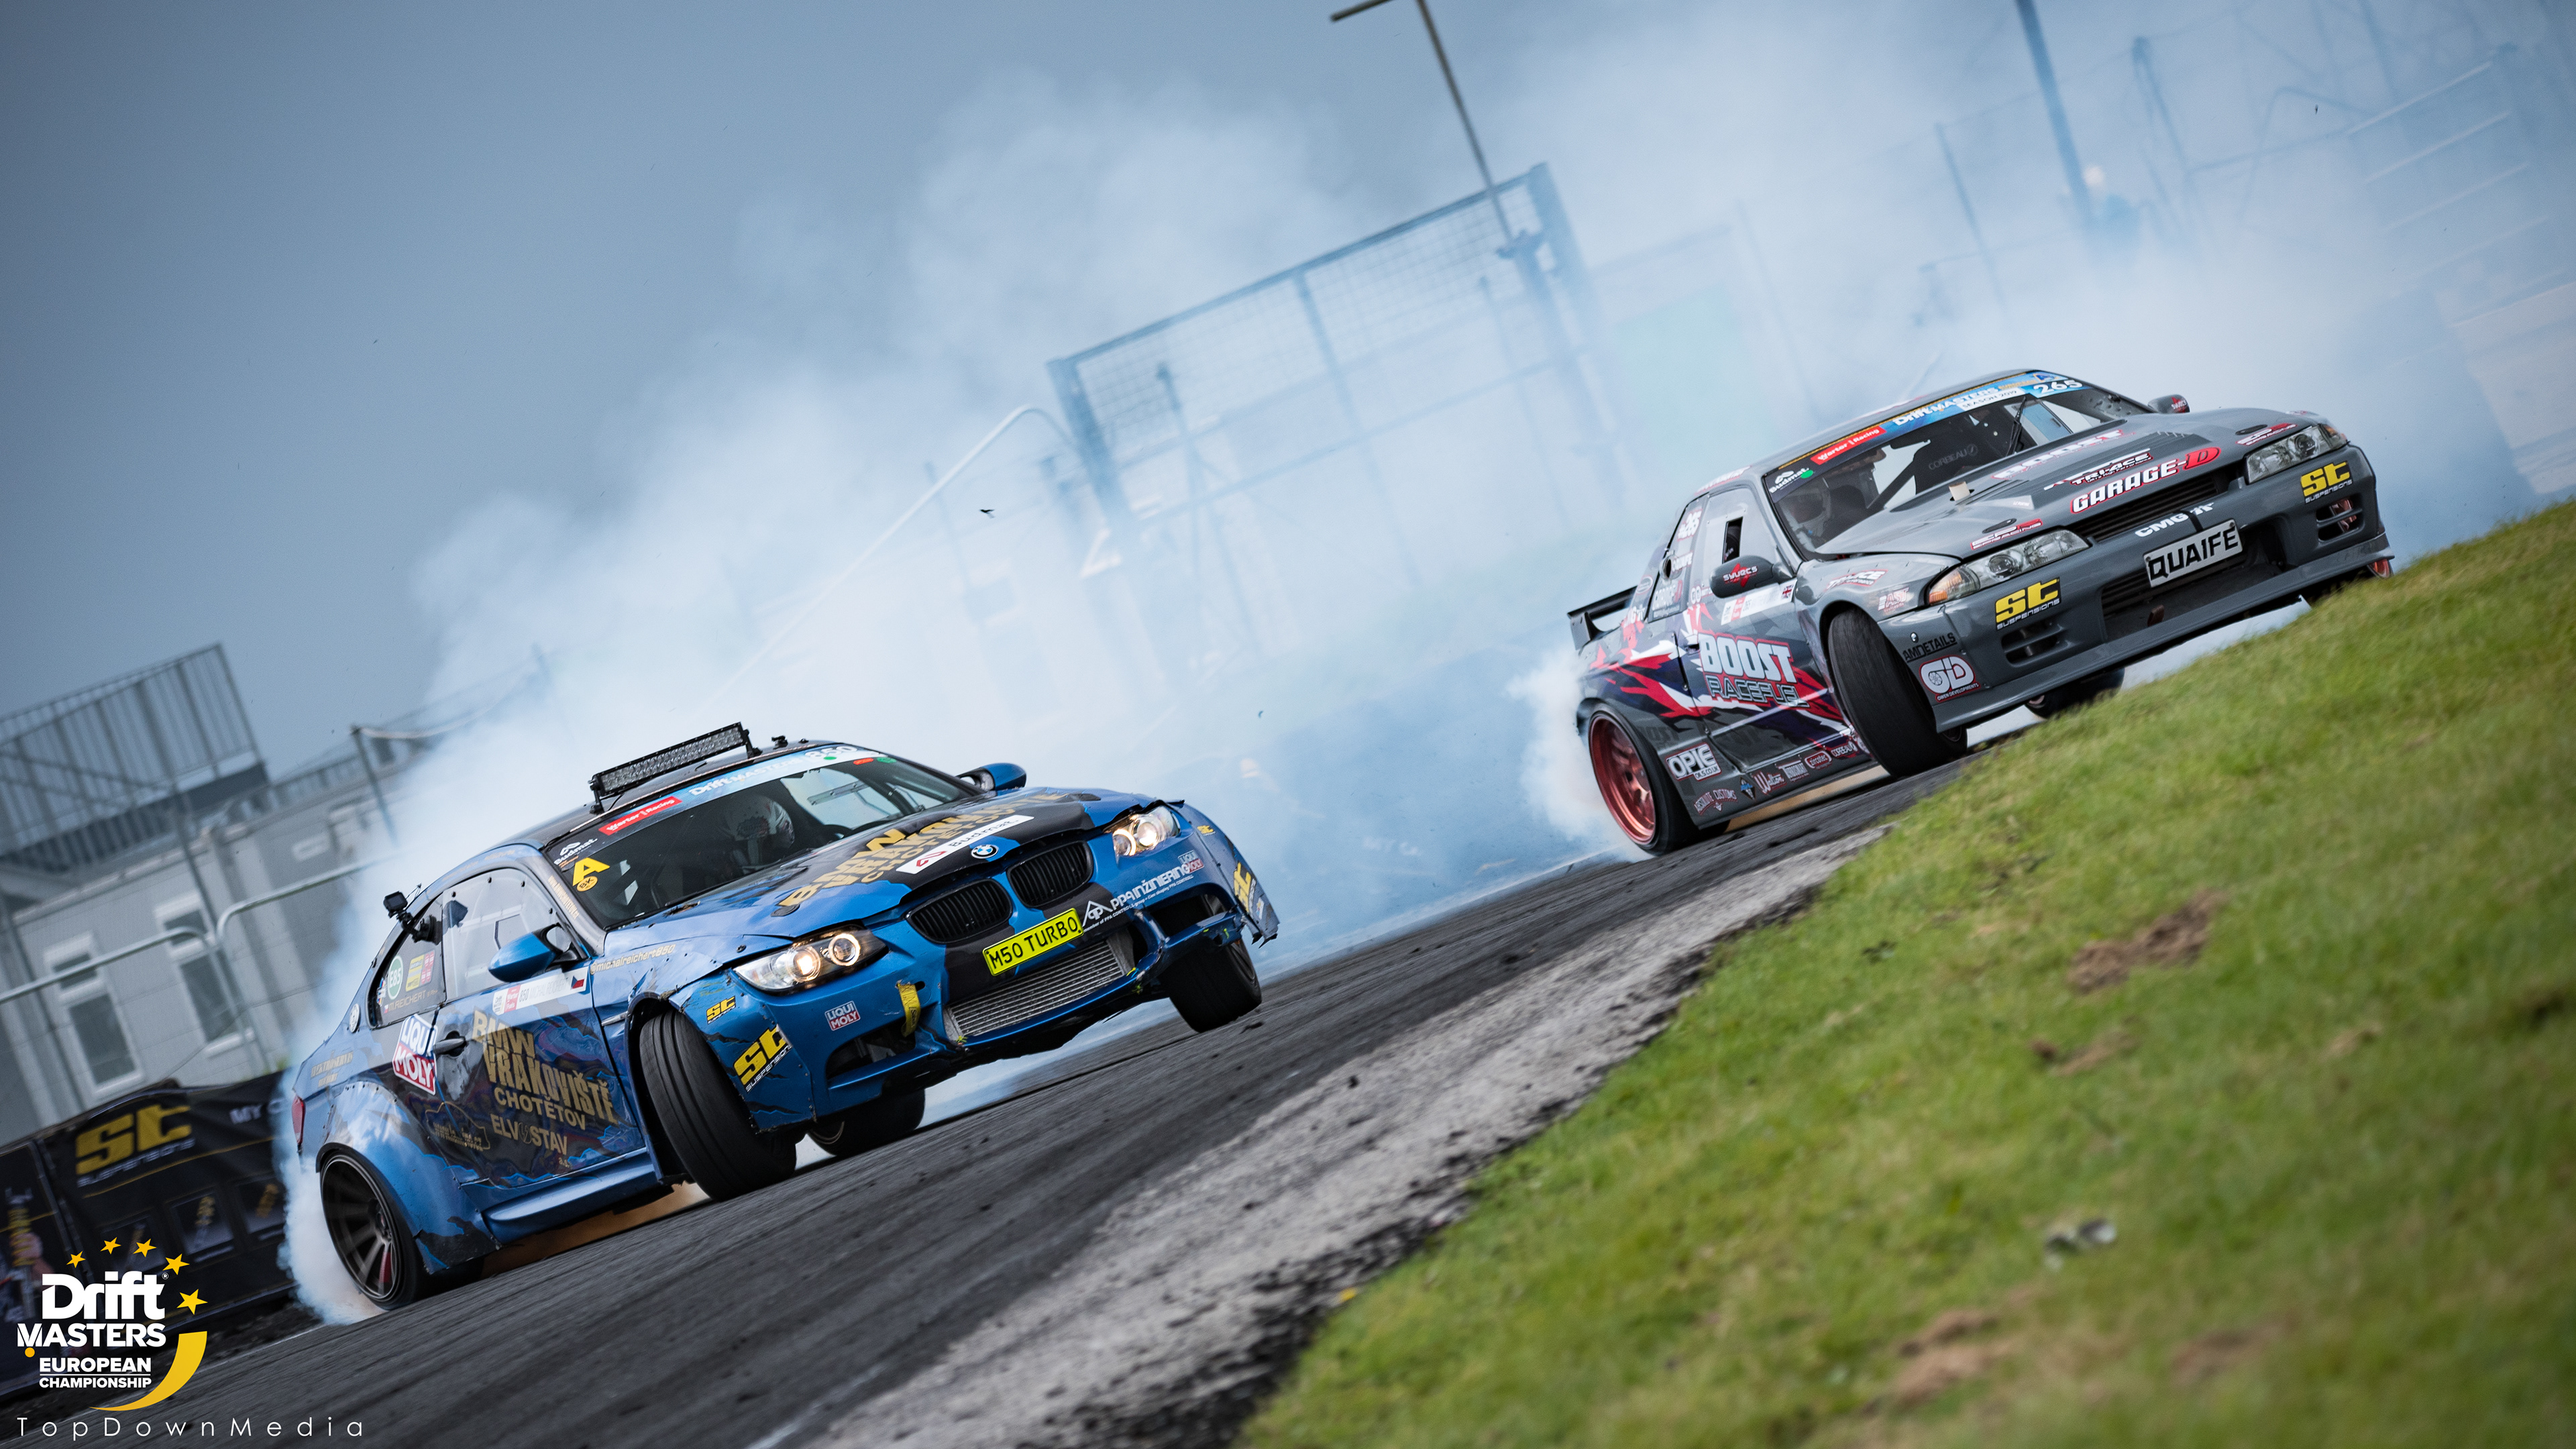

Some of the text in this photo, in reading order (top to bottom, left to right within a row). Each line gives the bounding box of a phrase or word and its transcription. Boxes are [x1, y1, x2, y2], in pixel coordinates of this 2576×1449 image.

[2033, 380, 2083, 394] 265
[1892, 404, 1934, 425] Drift
[1817, 429, 1880, 460] Warter Racing
[1928, 448, 1968, 470] CORBEAU
[2072, 447, 2221, 513] GARAGE-D
[2135, 513, 2189, 537] CMG
[2148, 527, 2239, 581] QUAIFE
[1997, 598, 2060, 630] SUSPENSIONS
[1698, 633, 1797, 684] BOOST
[1705, 675, 1810, 708] RACEFUEL
[804, 746, 857, 760] 850
[1668, 745, 1717, 780] OPIE
[688, 776, 732, 796] Drift
[606, 798, 675, 831] Warter Racing
[989, 915, 1079, 969] M50 TURBO
[590, 943, 676, 975] @michalreichert850
[389, 967, 401, 988] E85
[519, 988, 529, 1002] 850
[826, 1004, 855, 1020] LIQUI
[830, 1012, 860, 1030] MOLY
[401, 1018, 436, 1056] LIQUI
[472, 1008, 535, 1058] BMW
[395, 1045, 436, 1088] MOLY
[229, 1106, 262, 1125] MY
